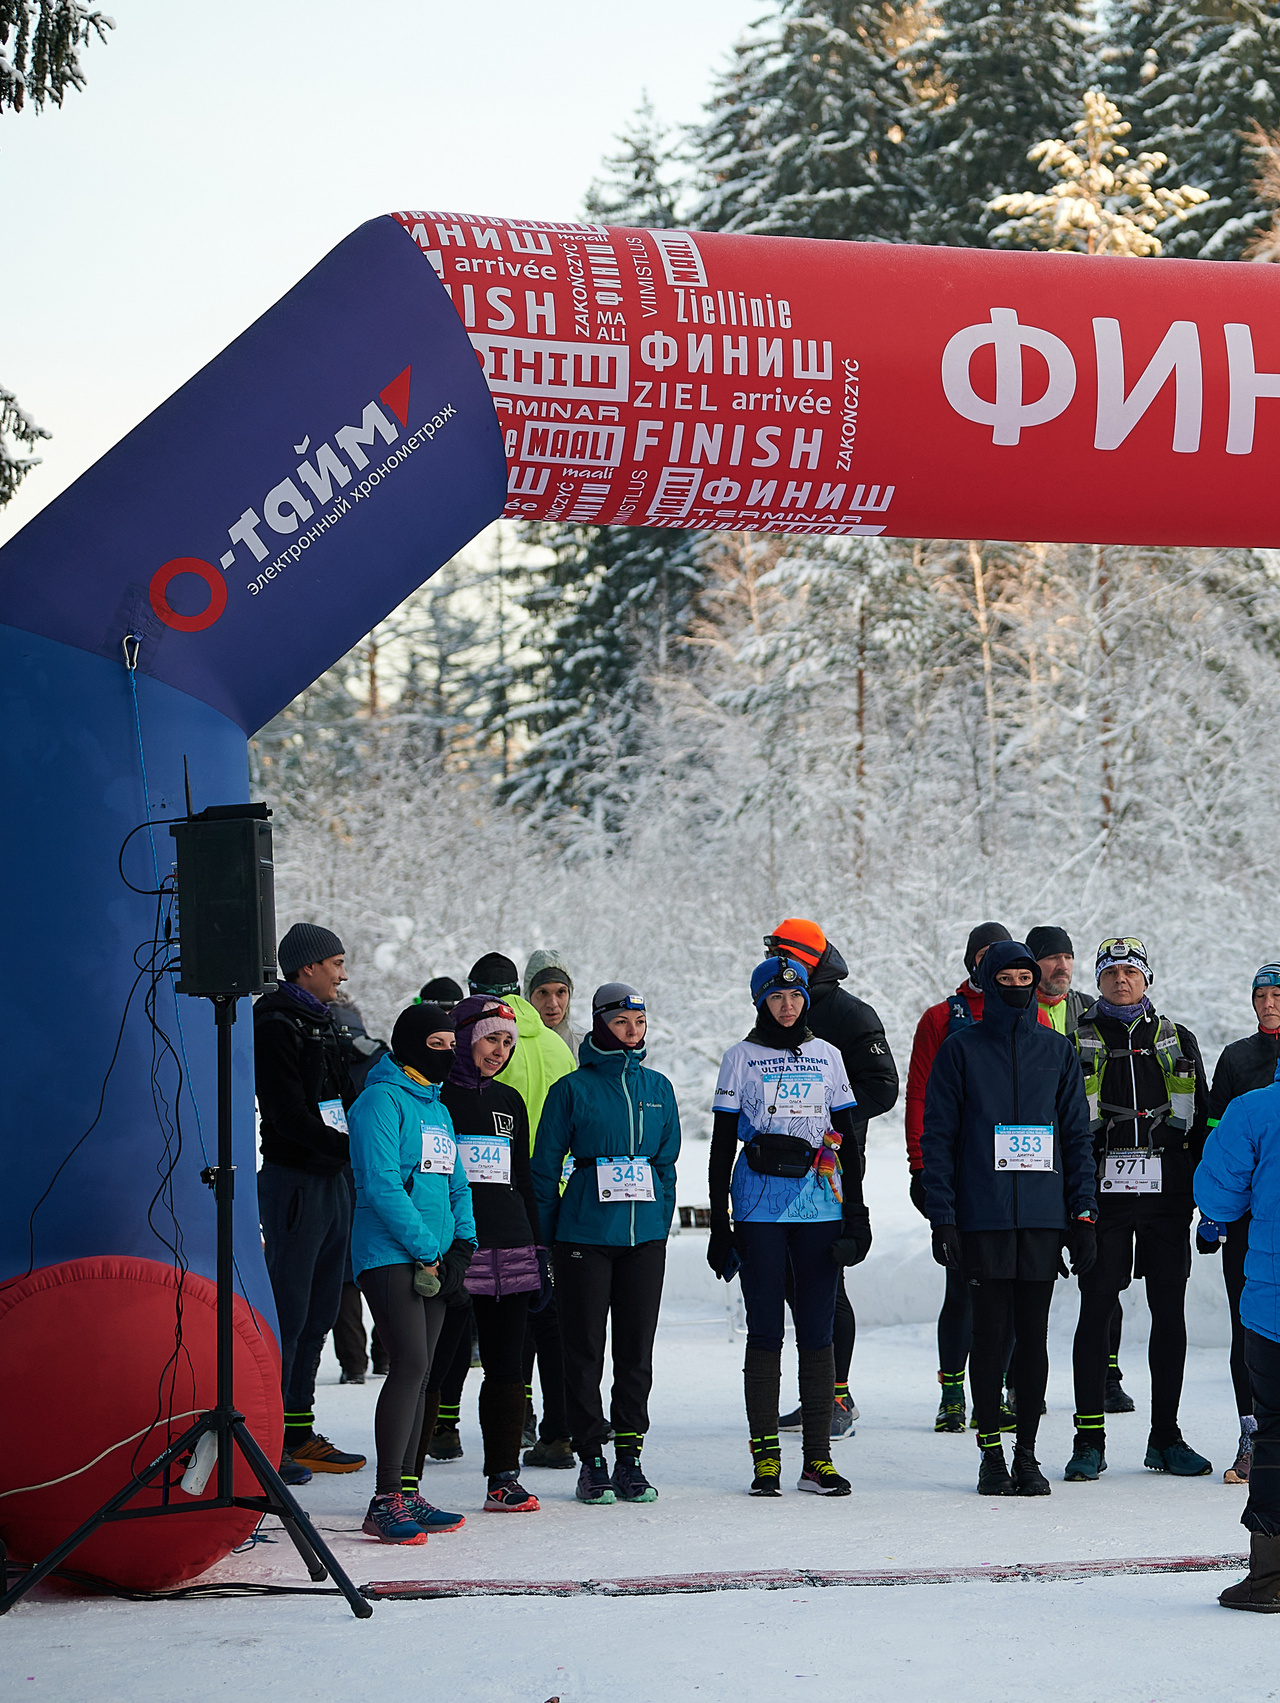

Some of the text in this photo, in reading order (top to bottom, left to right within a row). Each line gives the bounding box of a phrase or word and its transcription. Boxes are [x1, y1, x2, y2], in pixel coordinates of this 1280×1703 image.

[404, 223, 553, 255] ИНИШ
[557, 233, 608, 242] maali
[455, 257, 557, 281] arrivée
[585, 244, 624, 306] ФИНИШ
[626, 237, 659, 318] VIIMISTLUS
[566, 242, 590, 338] ZAKOŃCZYĆ
[448, 284, 556, 336] ISH
[674, 288, 792, 329] Ziellinie
[640, 330, 833, 381] ФИНИШ
[493, 397, 619, 422] RMINAR
[633, 381, 832, 415] ZIEL arrivée
[836, 358, 860, 471] ZAKOŃCZYĆ
[527, 427, 615, 461] MAALI
[633, 420, 823, 470] FINISH
[562, 467, 614, 479] maali
[247, 403, 458, 596] электронный хронометраж
[702, 477, 895, 512] ФИНИШ
[693, 508, 863, 523] TERMINAR
[747, 1056, 829, 1067] WINTER EXTREME
[761, 1065, 792, 1073] ULTRA
[778, 1083, 811, 1099] 347
[433, 1136, 452, 1155] 359
[469, 1146, 500, 1164] 344
[1009, 1136, 1042, 1152] 353
[612, 1165, 644, 1182] 345
[1115, 1159, 1146, 1174] 971
